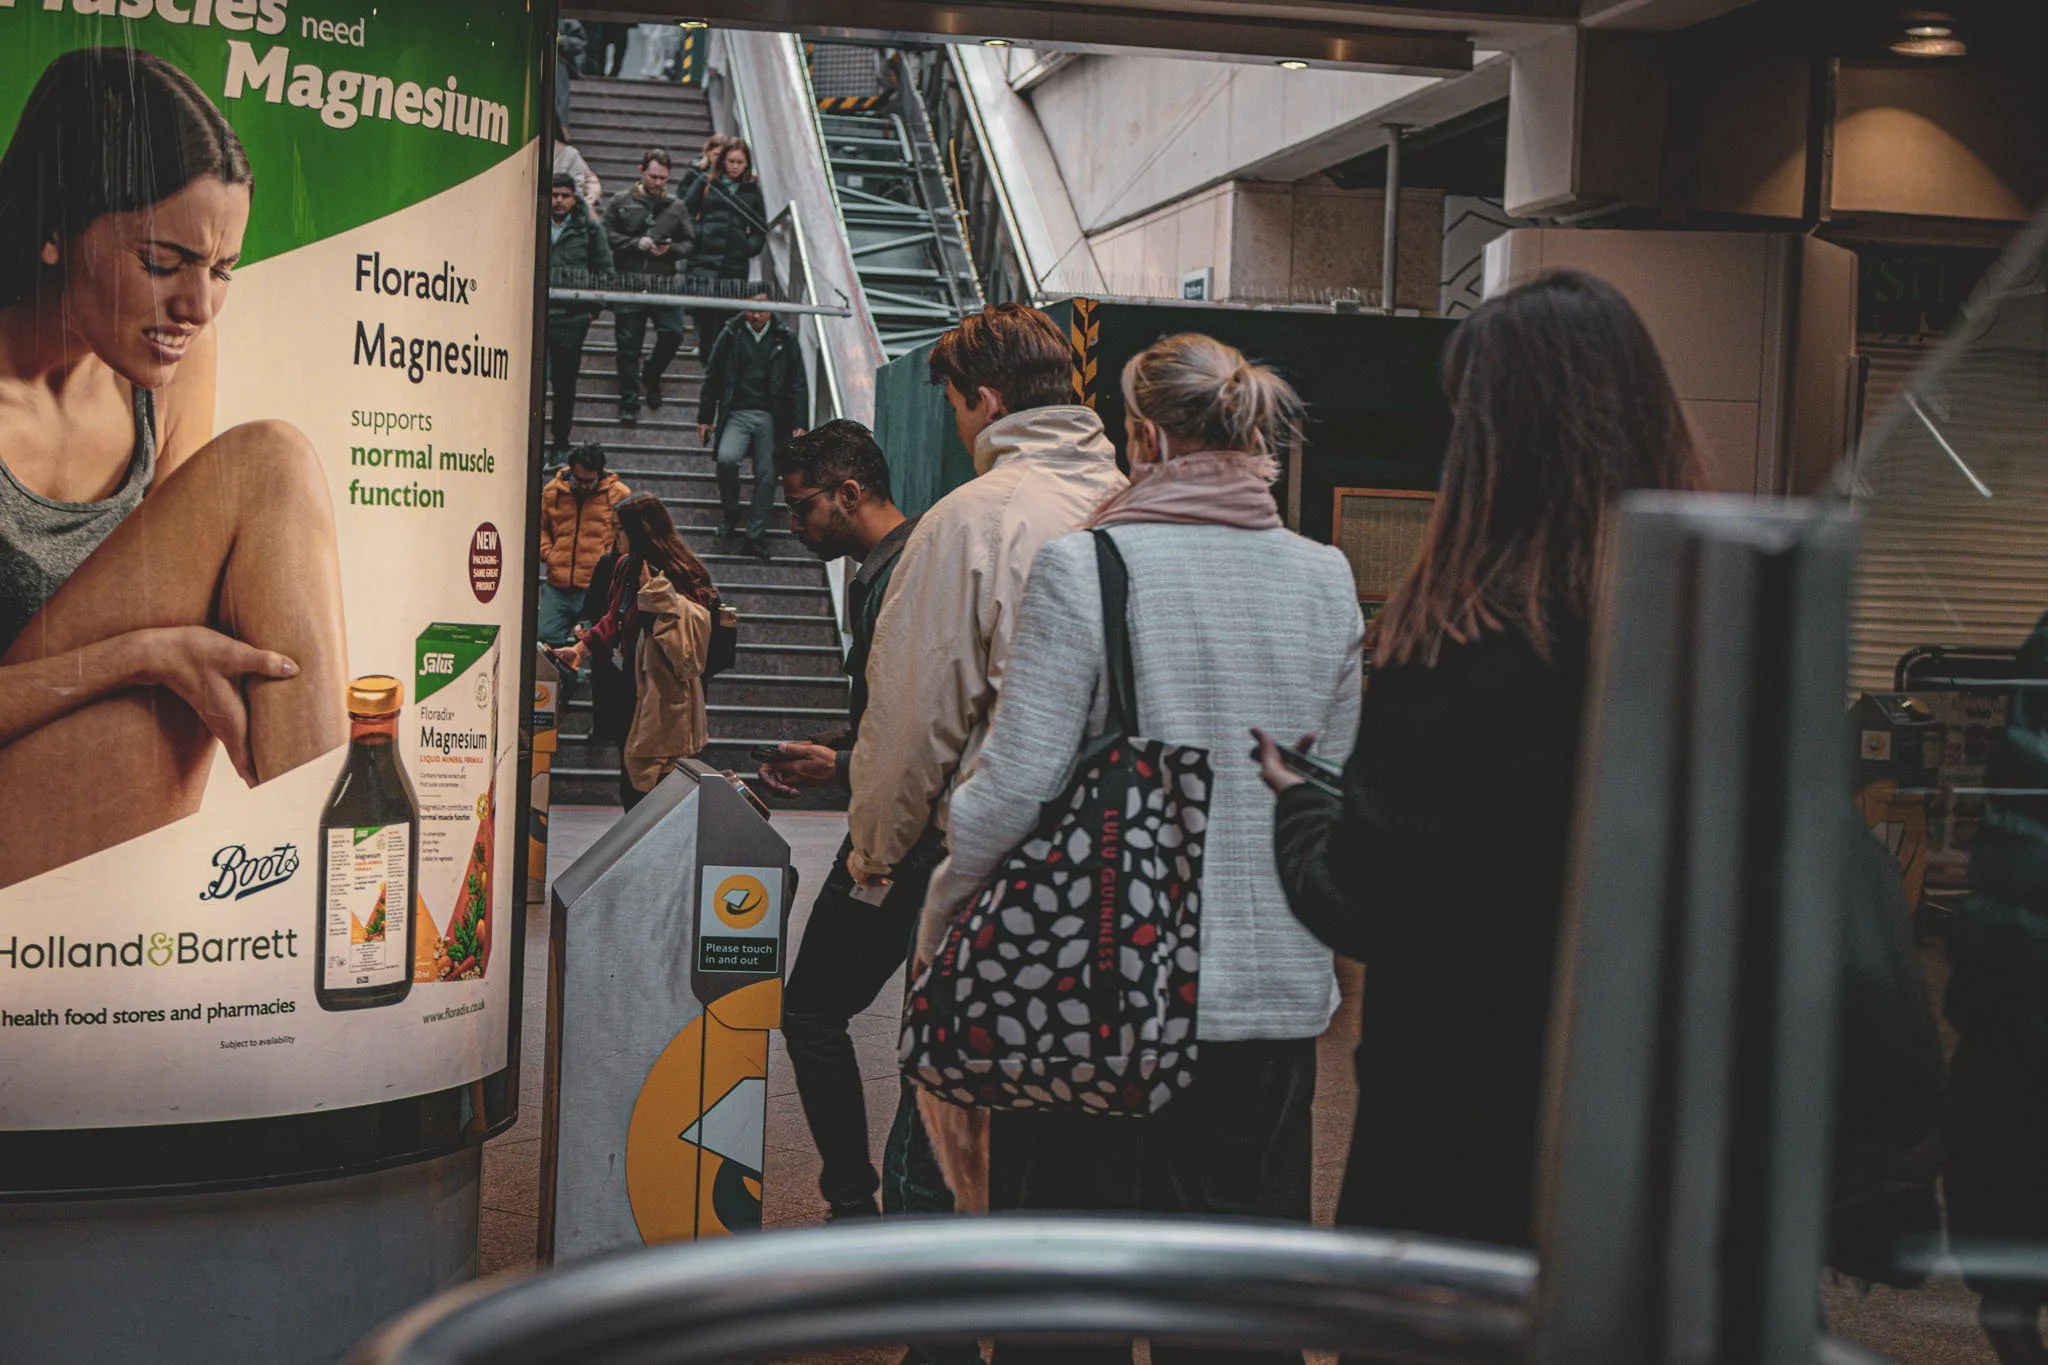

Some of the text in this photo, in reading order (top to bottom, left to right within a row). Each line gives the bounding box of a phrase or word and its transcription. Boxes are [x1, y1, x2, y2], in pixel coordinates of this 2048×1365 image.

[302, 14, 365, 47] need
[224, 40, 510, 145] Magnesium
[353, 320, 509, 384] Magnesium
[351, 409, 432, 435] supports
[350, 444, 495, 473] normal muscle
[349, 479, 445, 508] function
[476, 531, 498, 550] NEW
[418, 652, 456, 676] Salus
[420, 726, 487, 755] Magnesium
[199, 843, 300, 901] Boots
[1098, 809, 1120, 972] LULU GUINNESS
[177, 928, 298, 964] Barrett
[705, 955, 759, 965] in and out
[706, 943, 773, 954] Please touch
[2, 998, 296, 1027] health food stores and pharmacies
[422, 998, 486, 1024] www.floradix.co.uk
[220, 1035, 296, 1050] Subject to availability
